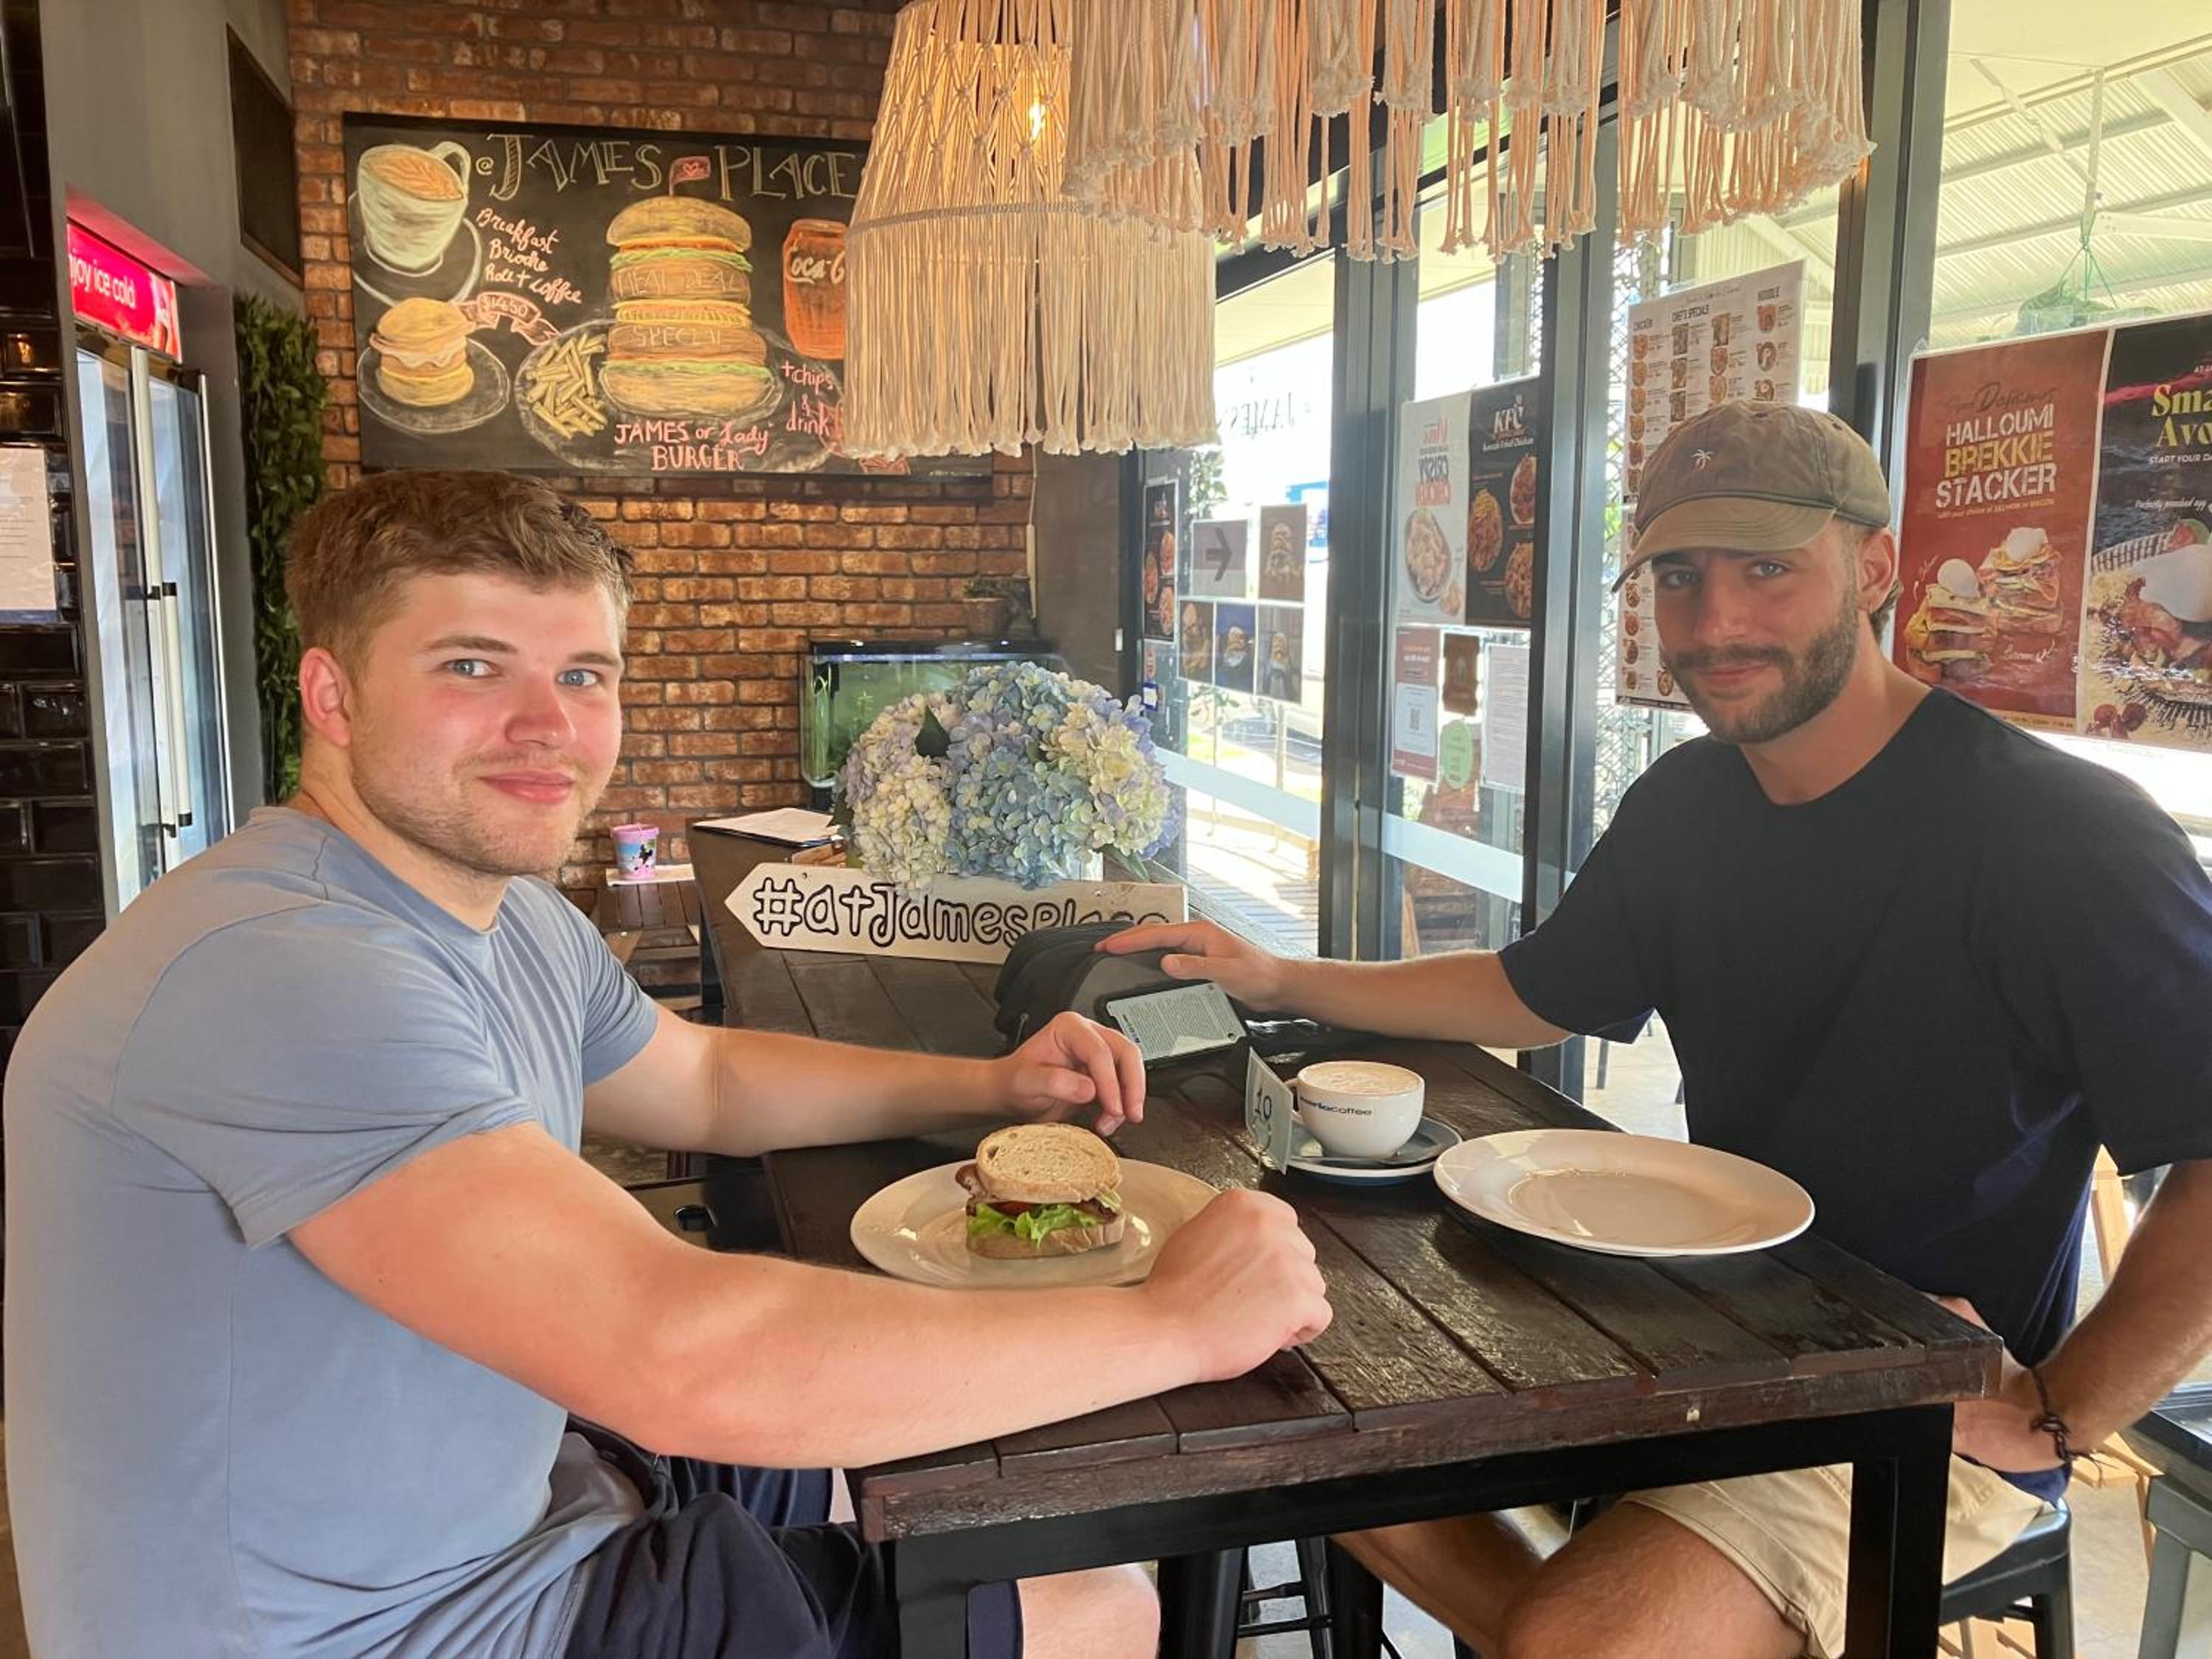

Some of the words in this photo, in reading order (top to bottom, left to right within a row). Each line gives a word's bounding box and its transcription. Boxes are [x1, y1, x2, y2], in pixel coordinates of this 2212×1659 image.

[487, 133, 662, 201] JAMES
[714, 145, 856, 201] PLACE
[476, 208, 560, 254] Breakfast
[93, 260, 111, 296] ice
[113, 275, 136, 310] cold
[614, 420, 690, 444] JAMES
[695, 425, 716, 439] or
[1946, 404, 2053, 447] HALLOUMI
[650, 444, 744, 472] BURGER
[1944, 430, 2053, 479] BREKKIE
[2149, 455, 2174, 465] START
[2177, 453, 2202, 464] YOUR
[1935, 462, 2057, 508] STACKER
[1254, 1085, 1272, 1120] 10
